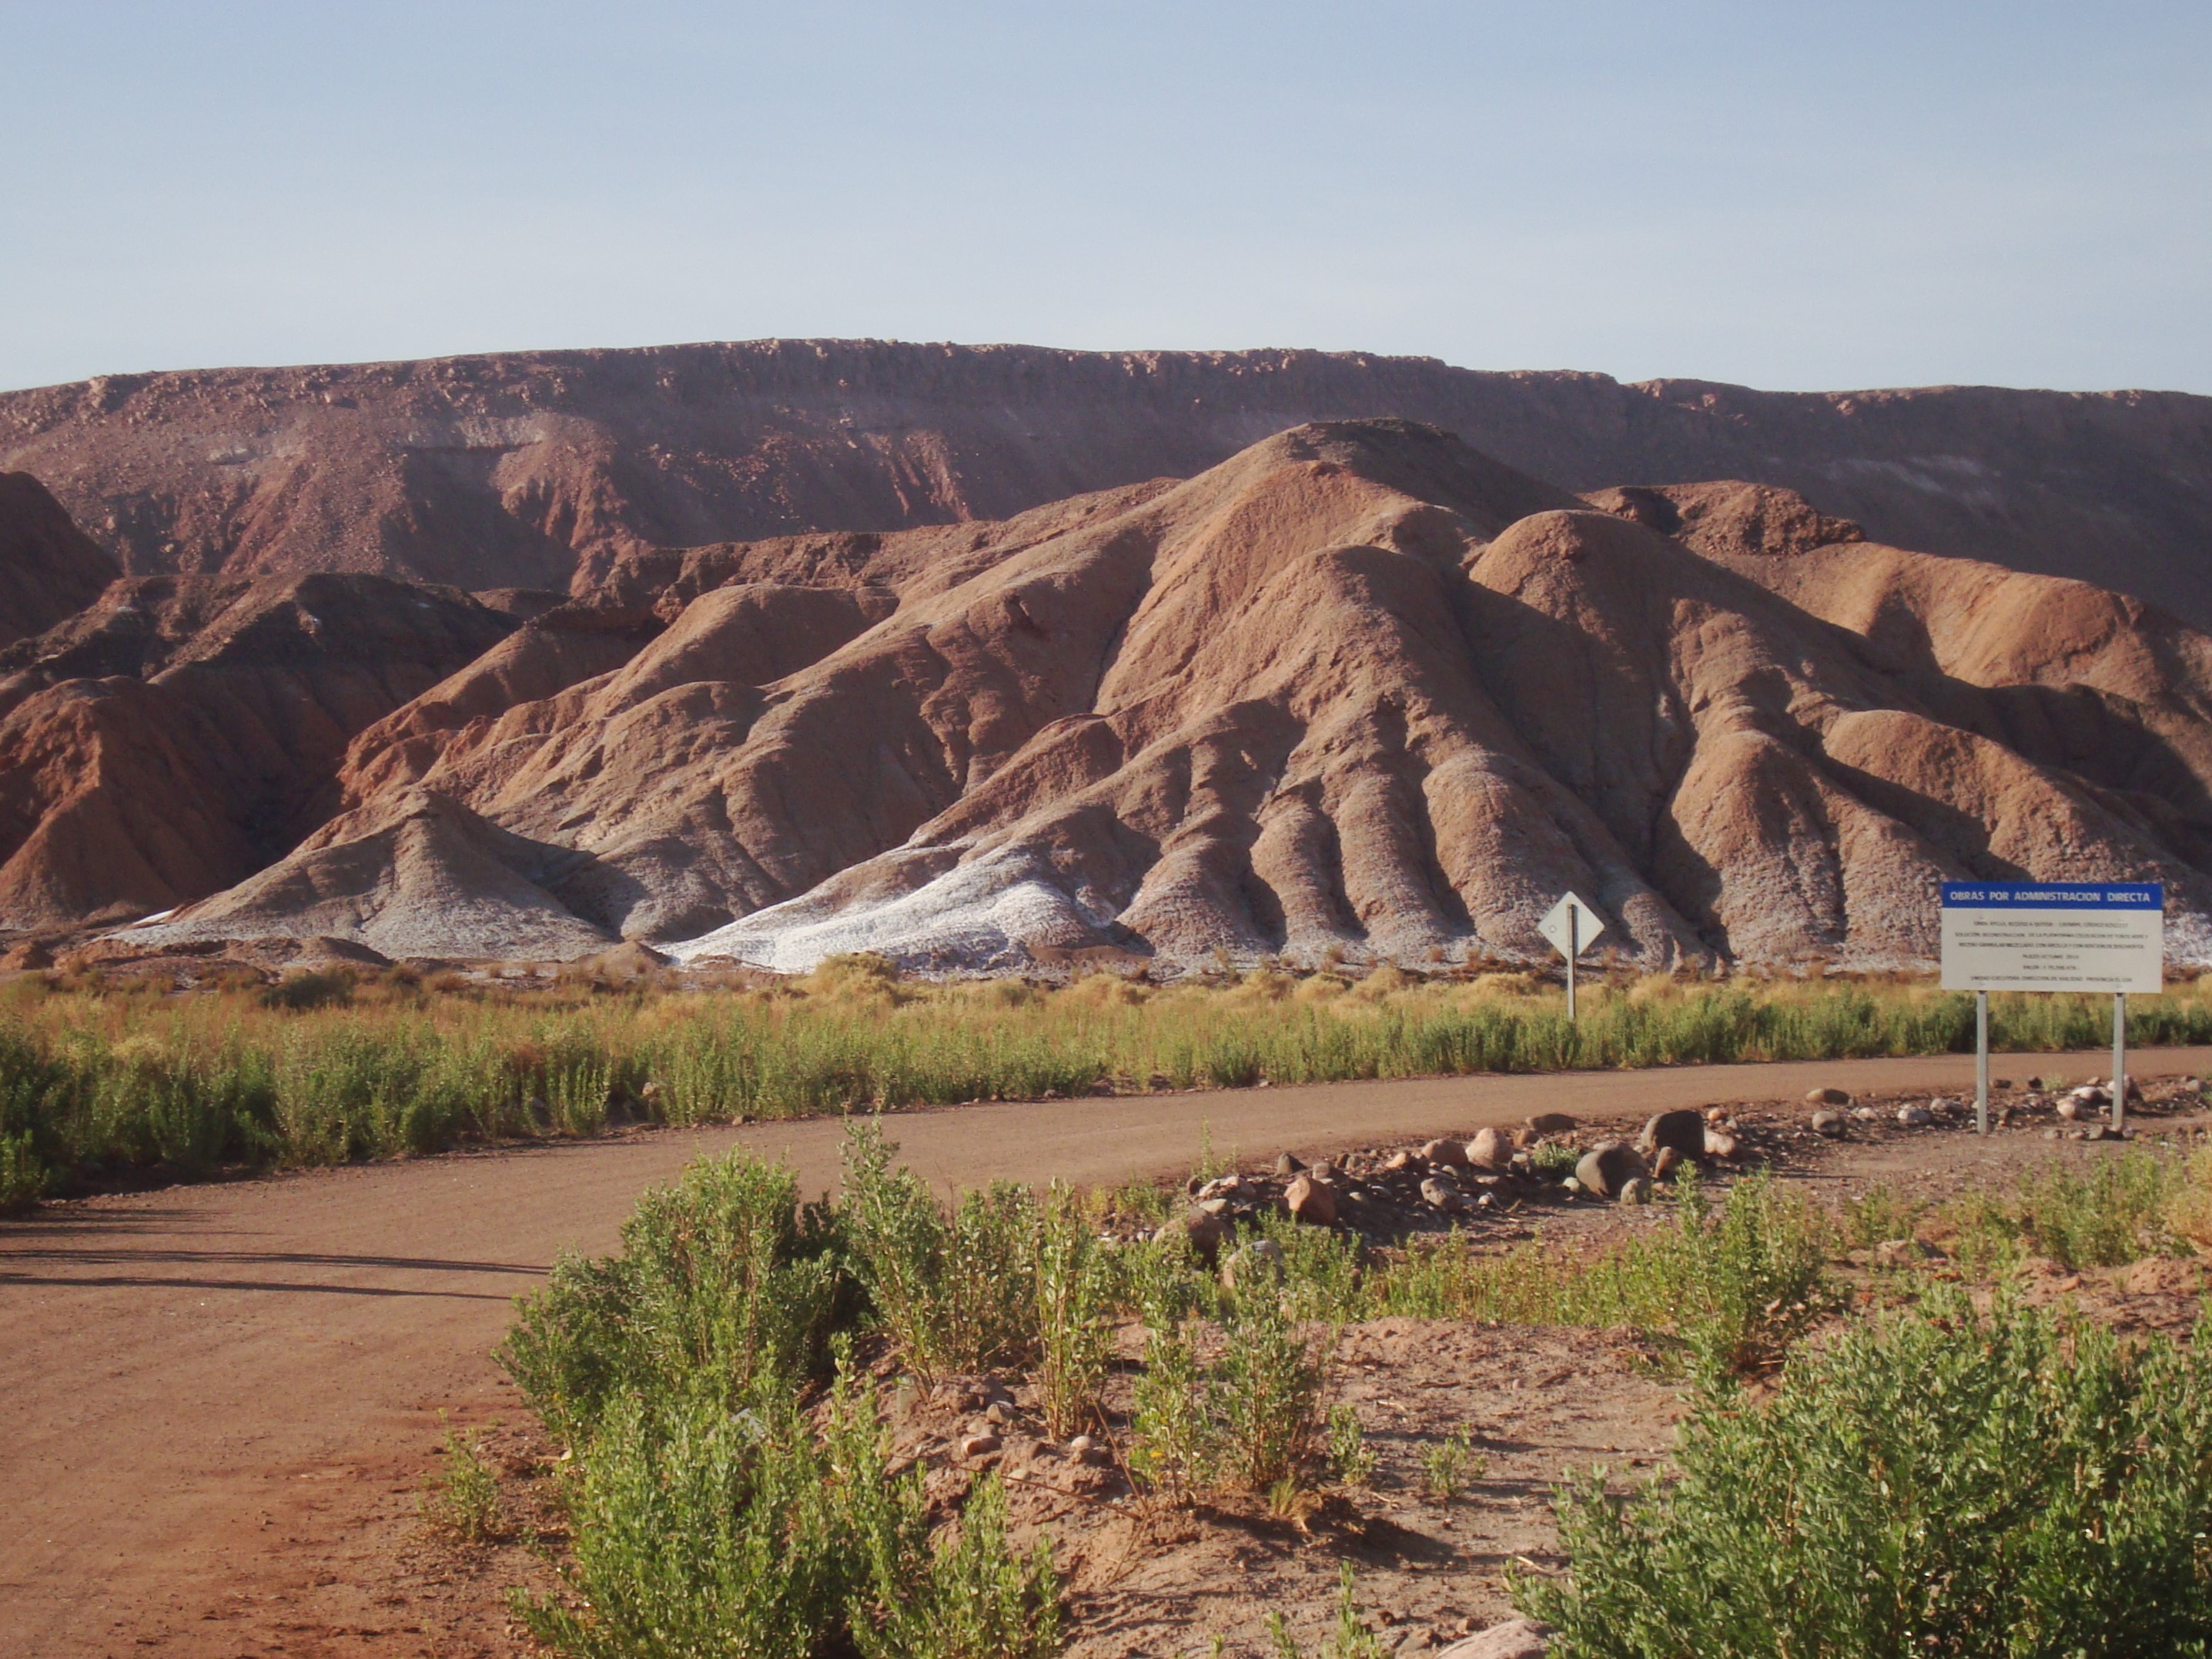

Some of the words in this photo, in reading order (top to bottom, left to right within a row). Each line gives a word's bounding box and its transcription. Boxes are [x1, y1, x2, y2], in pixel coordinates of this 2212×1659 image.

[1950, 891, 1985, 901] OBRAS
[1989, 891, 2010, 901] POR
[2014, 891, 2101, 901] ADMINISTRACION
[2107, 892, 2150, 902] DIRECTA
